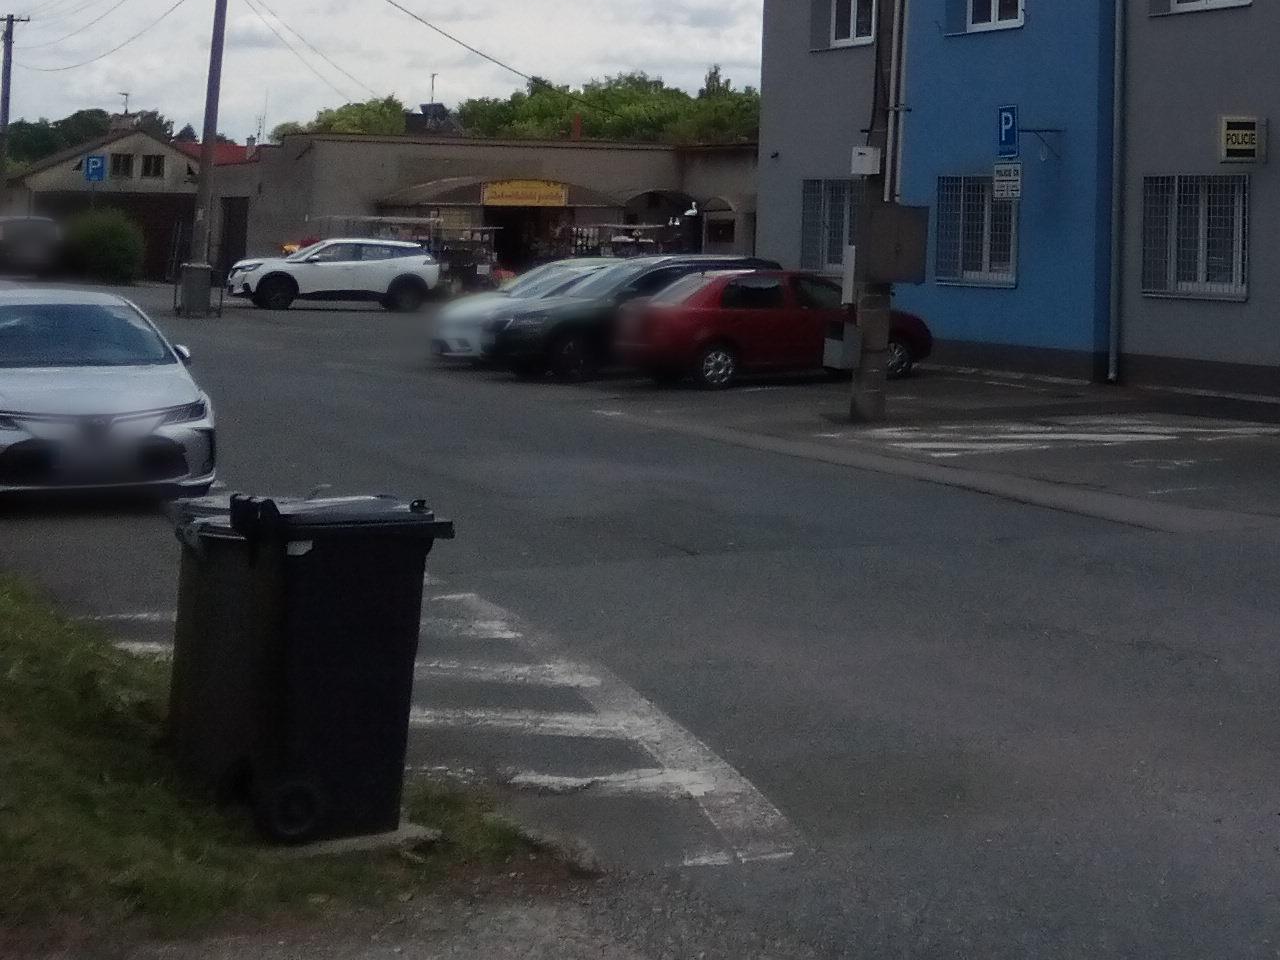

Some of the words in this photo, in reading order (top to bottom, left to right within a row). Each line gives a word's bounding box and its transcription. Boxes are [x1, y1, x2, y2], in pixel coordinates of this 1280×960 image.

[1001, 111, 1013, 141] P
[1226, 133, 1256, 145] POLICIE
[89, 159, 101, 174] P
